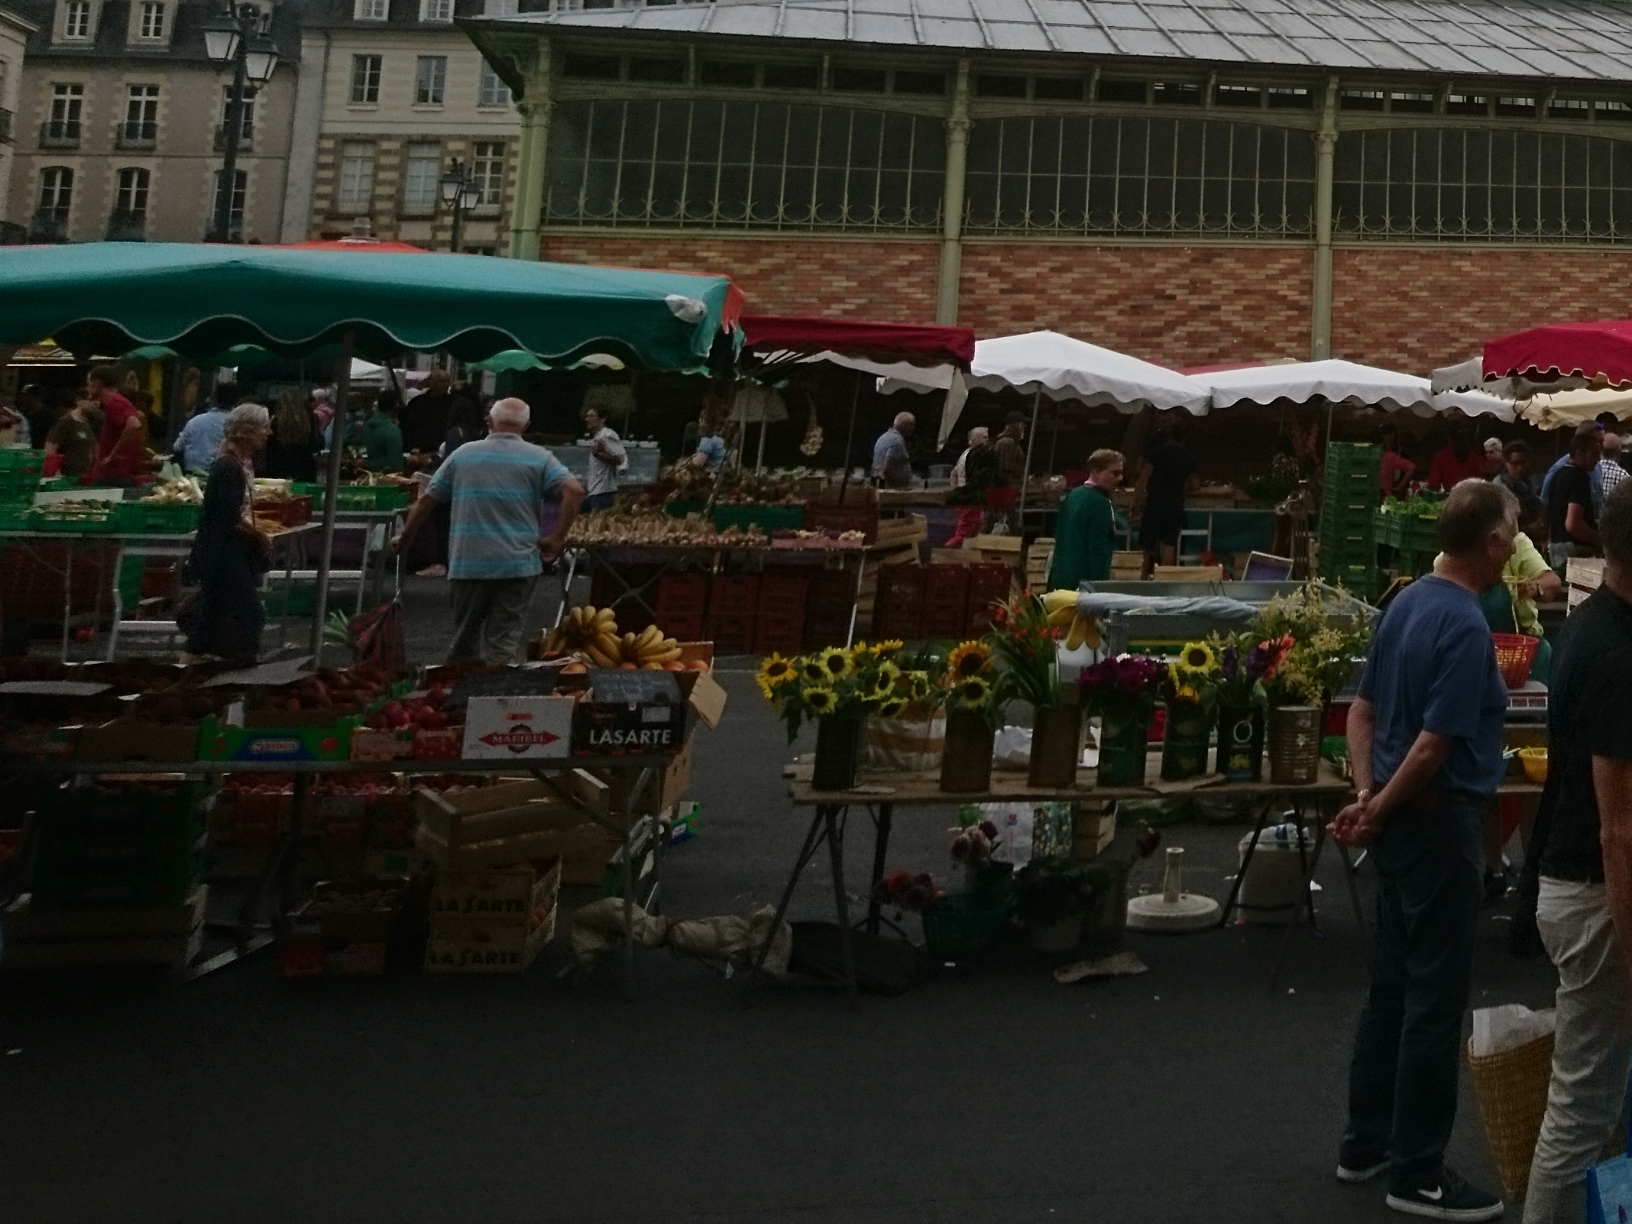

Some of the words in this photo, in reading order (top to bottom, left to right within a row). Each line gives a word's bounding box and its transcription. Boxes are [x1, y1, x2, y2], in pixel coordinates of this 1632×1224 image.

[491, 733, 547, 744] MARIBEL
[589, 729, 672, 745] LASARTE
[436, 898, 459, 912] LA
[462, 893, 525, 914] SARTE
[430, 952, 454, 964] LA
